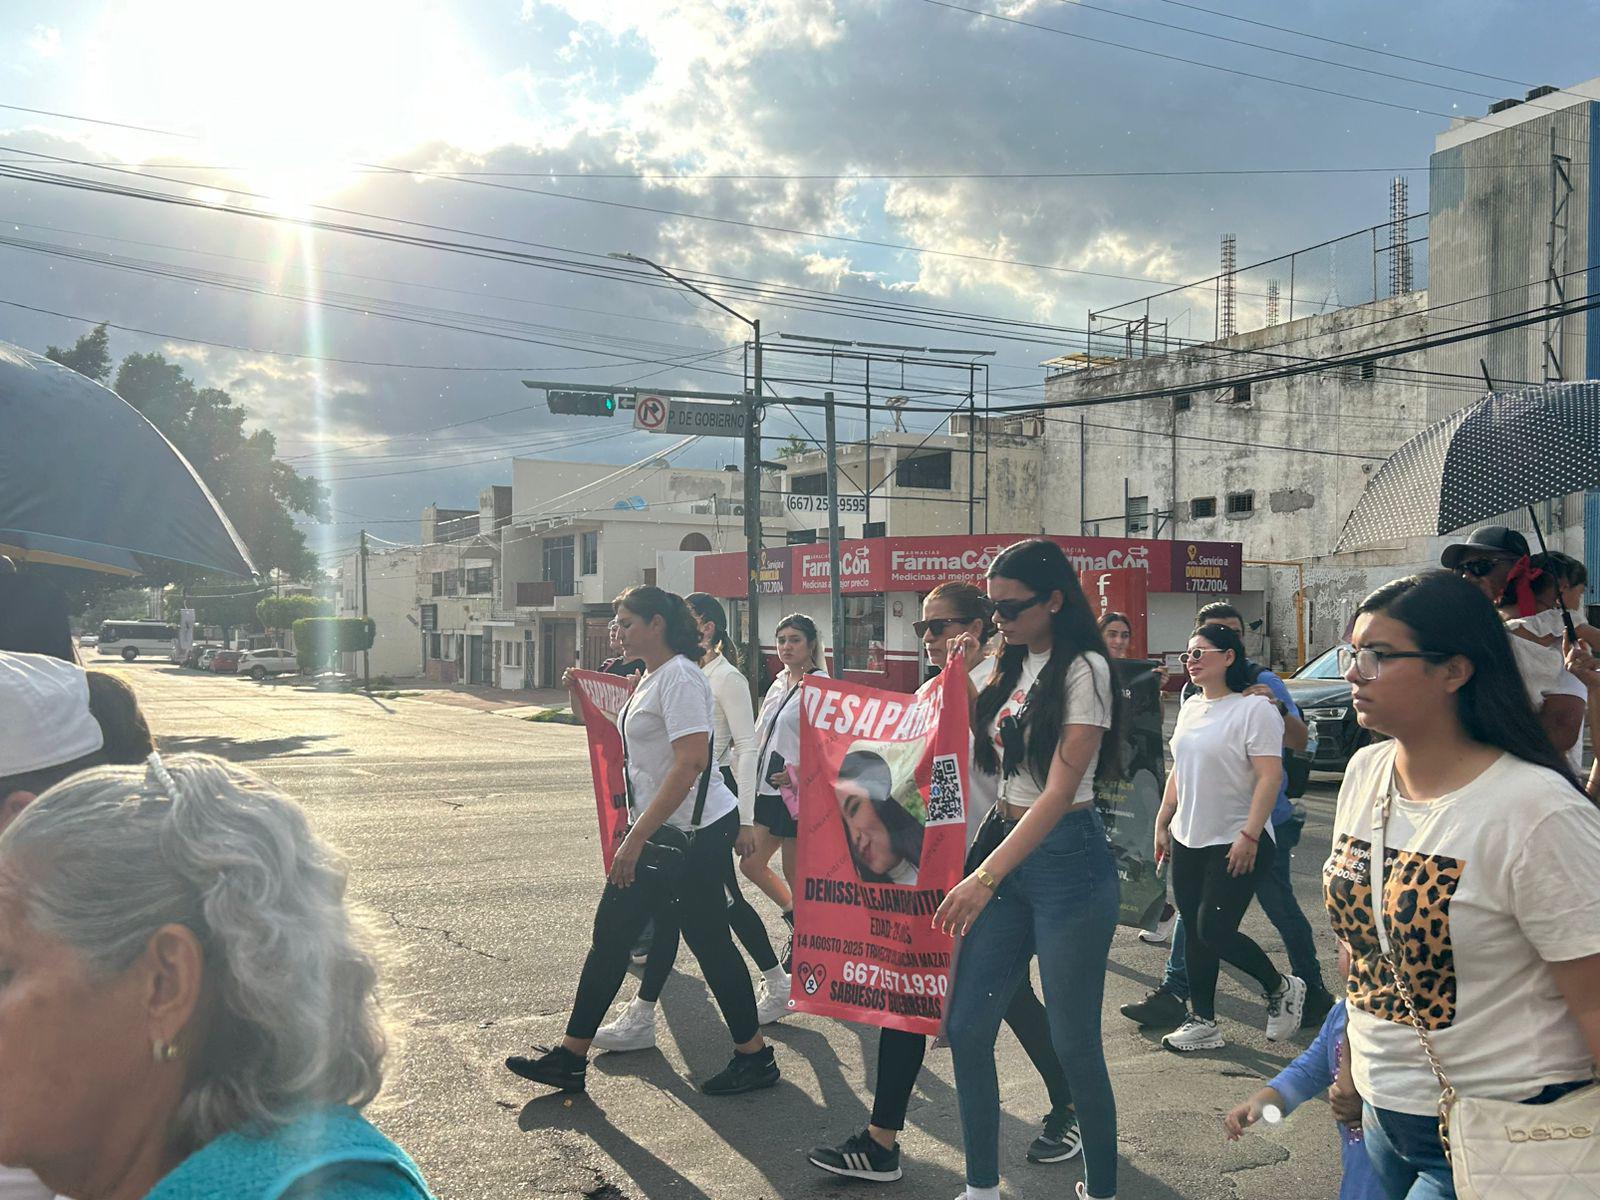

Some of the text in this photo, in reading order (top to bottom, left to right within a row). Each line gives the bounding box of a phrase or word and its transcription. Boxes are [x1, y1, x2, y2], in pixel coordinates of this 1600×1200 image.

[679, 410, 693, 426] DE
[695, 412, 745, 428] GOBIERNO
[786, 495, 866, 512] (667) 25-9595
[1198, 556, 1223, 566] Servicio
[851, 578, 869, 589] precio
[891, 572, 936, 581] Medicinas
[937, 571, 946, 580] al
[948, 571, 975, 582] mejor
[1192, 579, 1228, 592] 712.7004
[797, 933, 808, 947] 14
[809, 936, 841, 953] AGOSTO
[842, 940, 864, 956] 2025
[843, 960, 949, 997] 6671571930
[830, 980, 887, 1012] SABUESOS
[1504, 1121, 1594, 1144] bebe
